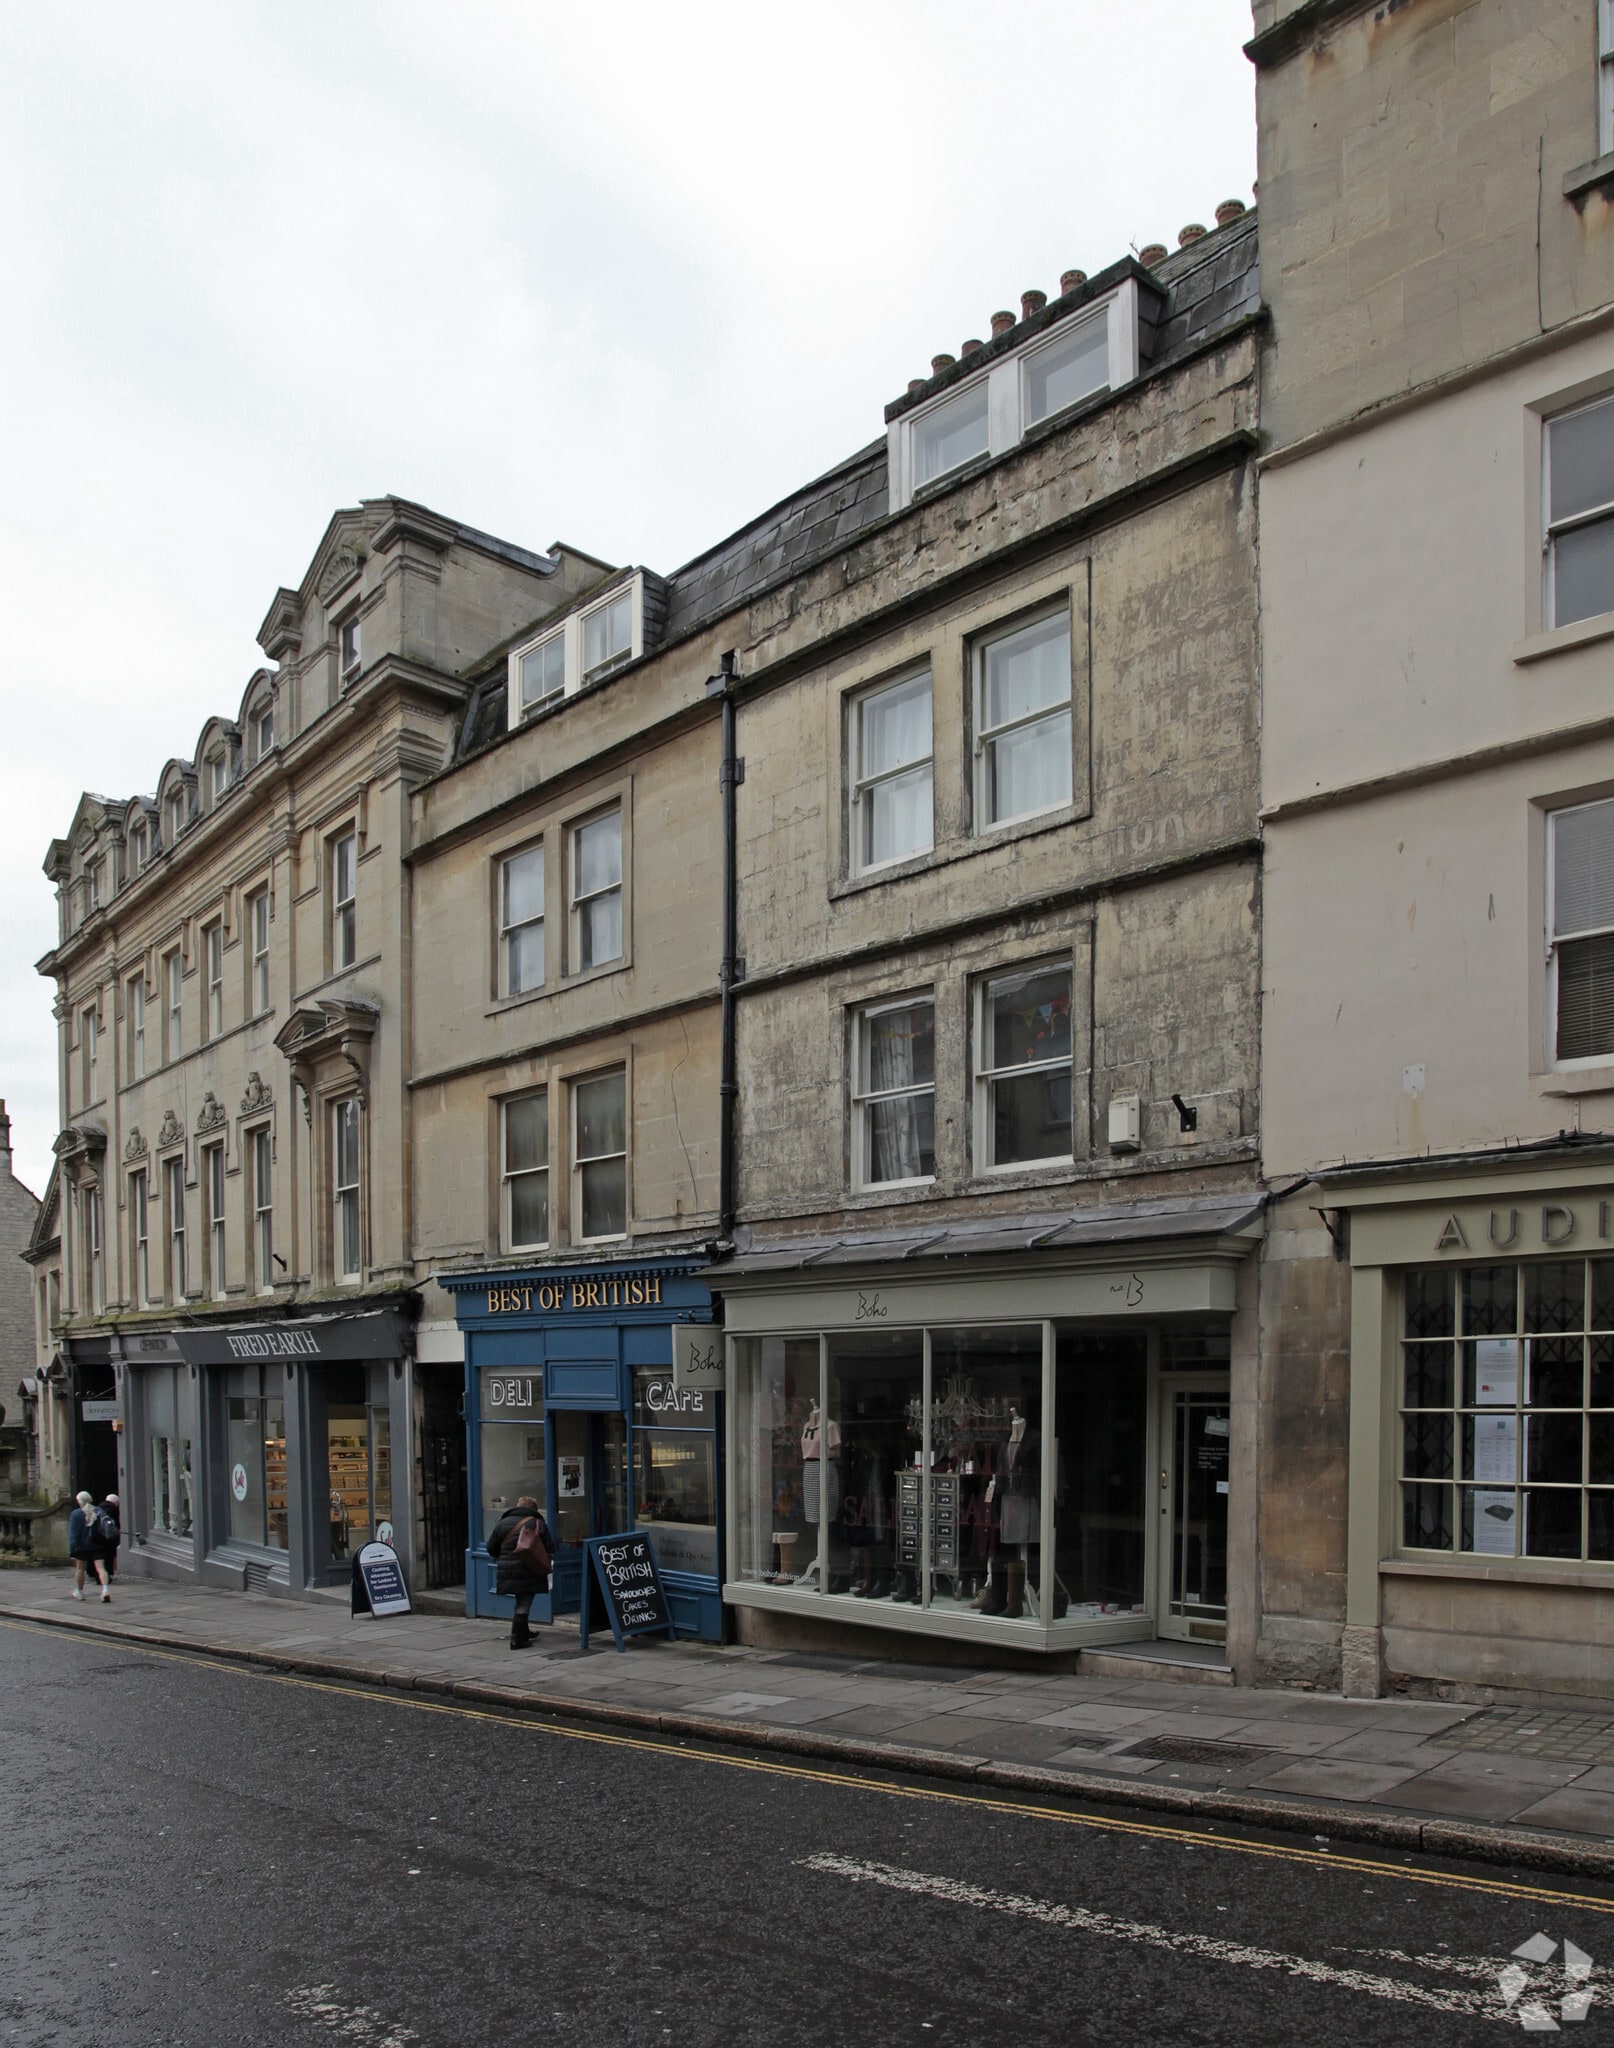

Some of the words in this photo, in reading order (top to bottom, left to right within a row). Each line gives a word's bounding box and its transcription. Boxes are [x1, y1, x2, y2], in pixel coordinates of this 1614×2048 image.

[1433, 1200, 1607, 1251] AUDI
[487, 1287, 533, 1313] BEST
[539, 1284, 565, 1310] OF
[571, 1278, 662, 1308] BRITISH
[855, 1292, 888, 1320] Boho
[226, 1334, 270, 1357] FIRED
[264, 1330, 321, 1356] EARTH
[687, 1342, 725, 1373] Boho
[490, 1379, 532, 1407] DELI
[598, 1545, 629, 1565] BEST
[633, 1544, 645, 1557] OF
[606, 1561, 653, 1586] BRITISH
[622, 1610, 657, 1626] DRINKS
